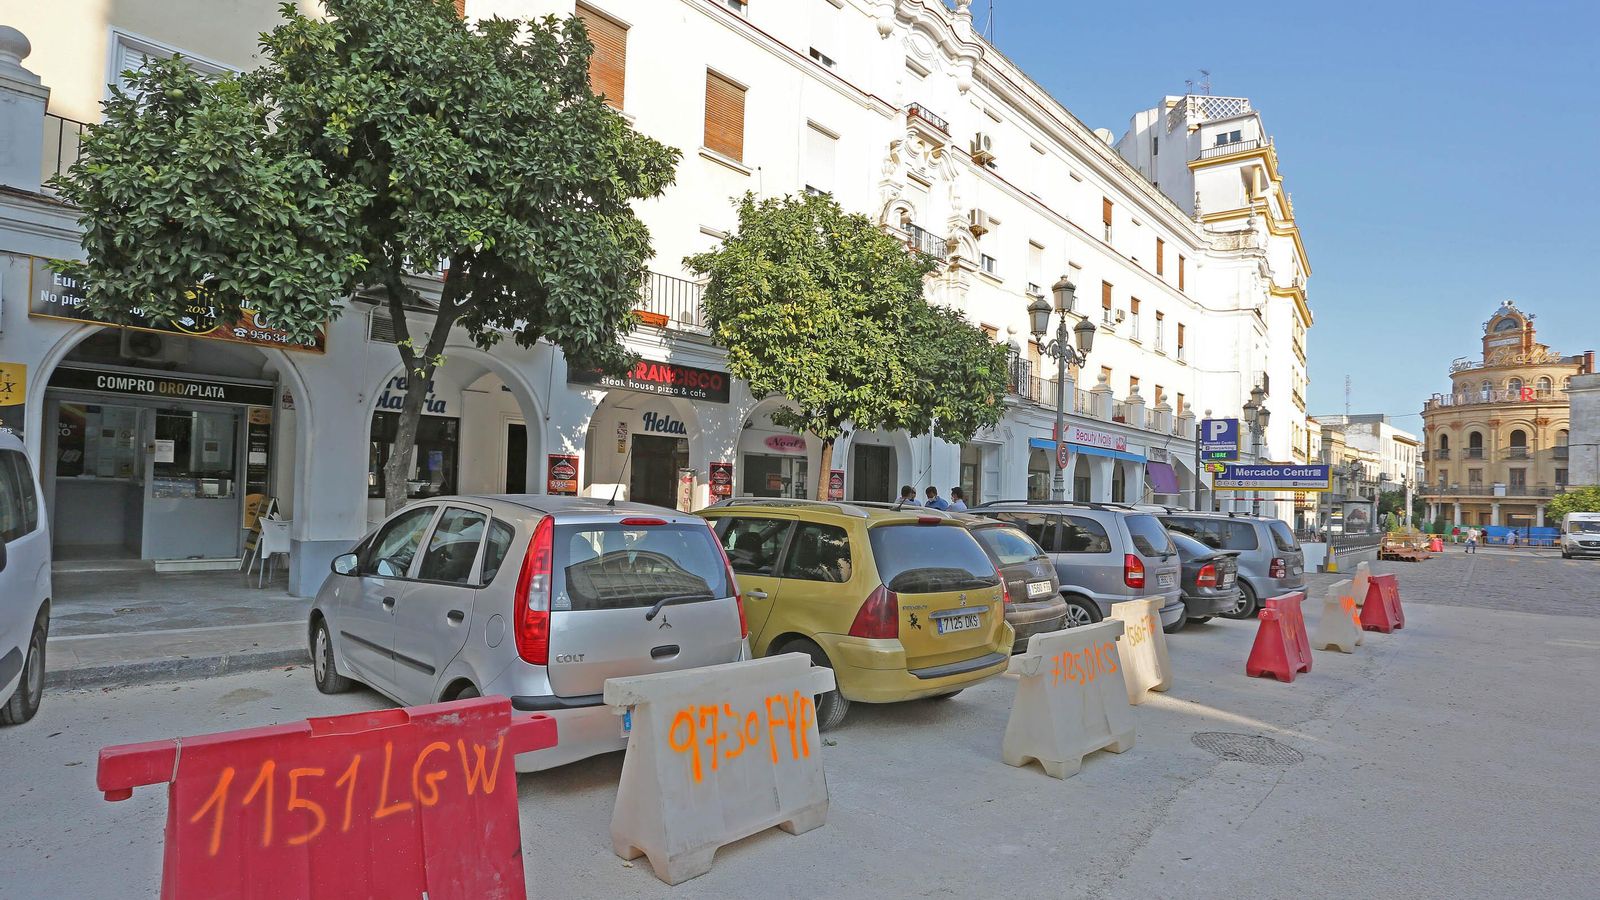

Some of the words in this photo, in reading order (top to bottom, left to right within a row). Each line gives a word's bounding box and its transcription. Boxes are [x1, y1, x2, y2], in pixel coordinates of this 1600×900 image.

[40, 290, 58, 303] No
[250, 330, 272, 341] 956
[96, 375, 155, 392] COMPRO
[601, 376, 626, 387] steak
[628, 379, 655, 391] house
[657, 384, 679, 394] pizza
[681, 387, 687, 395] &
[689, 388, 706, 398] cafe
[1075, 428, 1098, 445] Beauty
[1097, 433, 1112, 446] Nails
[1210, 420, 1228, 441] P
[1235, 467, 1280, 477] Mercado
[943, 616, 963, 630] 7125
[965, 614, 979, 628] DKS
[555, 653, 585, 664] COLT
